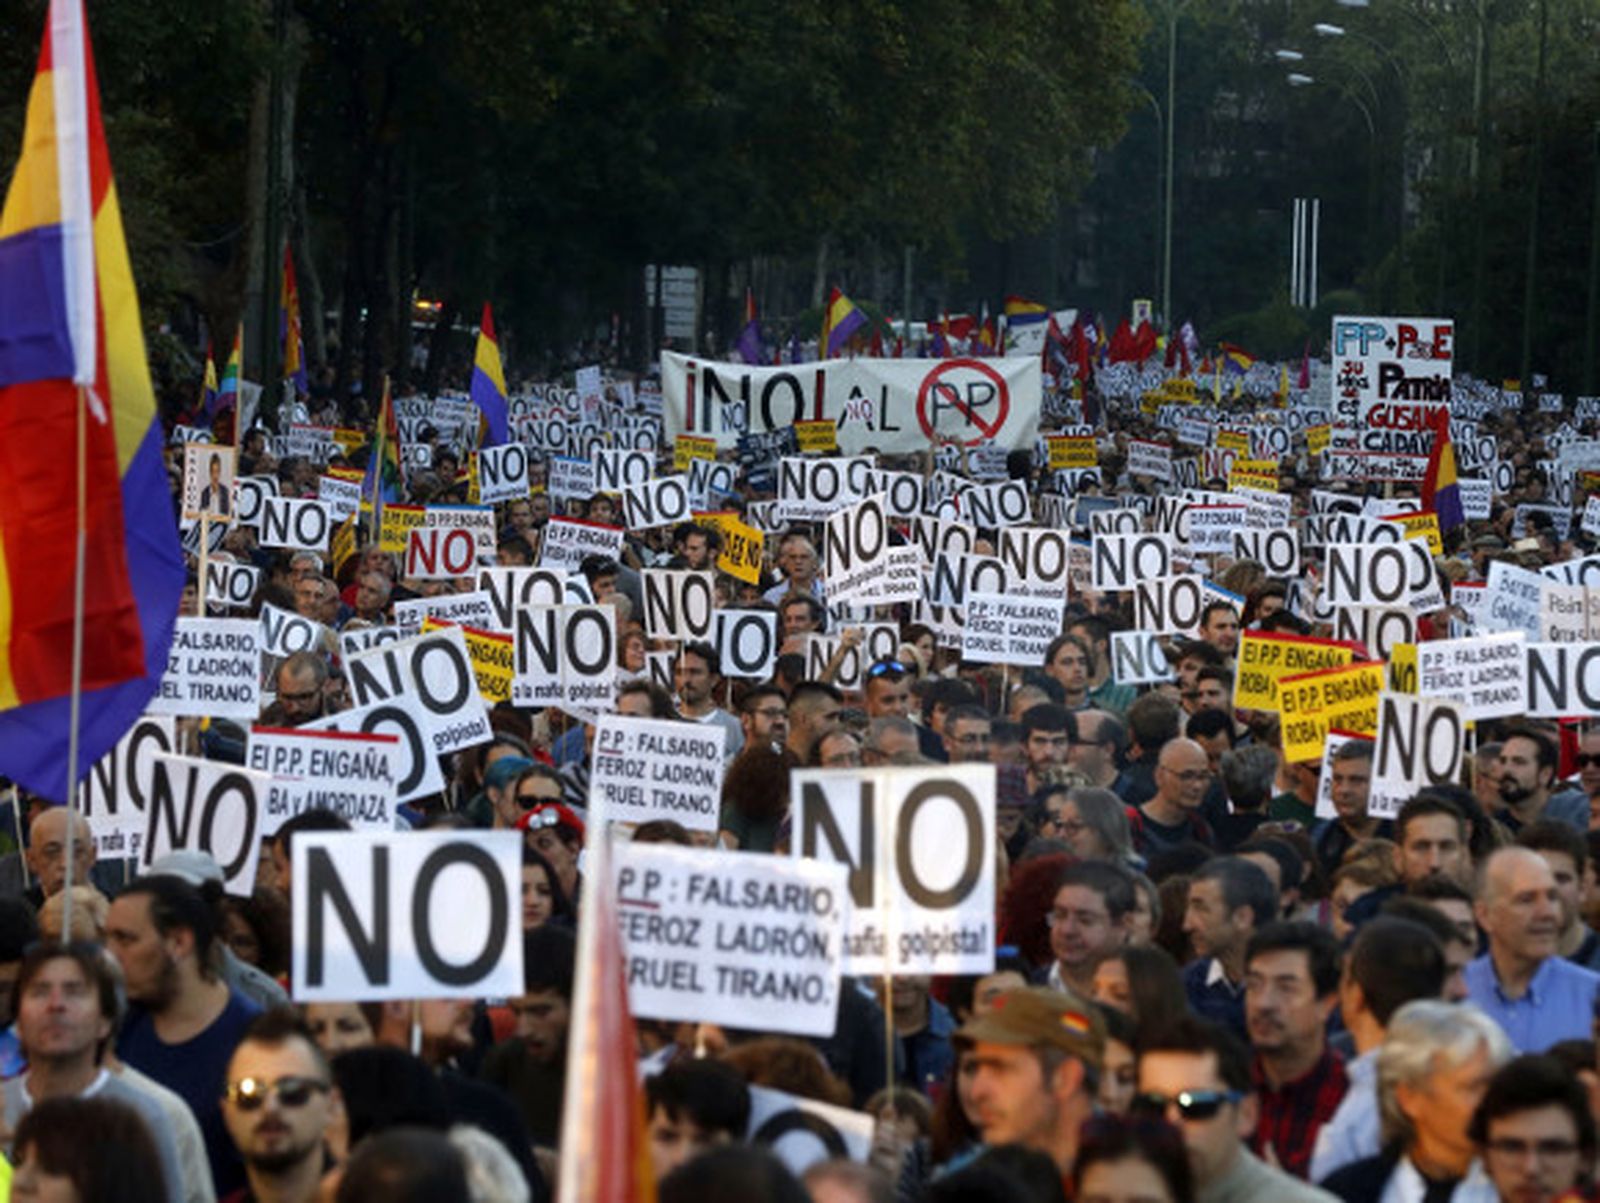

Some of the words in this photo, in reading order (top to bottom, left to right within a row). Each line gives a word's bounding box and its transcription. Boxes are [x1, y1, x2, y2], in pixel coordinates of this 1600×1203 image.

[1336, 322, 1387, 356] PP
[722, 402, 746, 433] NO
[847, 399, 873, 421] NO
[931, 382, 996, 428] PP
[1366, 403, 1442, 432] GUSAN
[528, 421, 566, 448] NO
[615, 431, 655, 451] NO
[1364, 432, 1437, 454] CADAV
[1461, 438, 1496, 466] NO
[481, 447, 525, 487] NO
[597, 451, 651, 489] NO
[690, 460, 732, 494] NO
[782, 460, 839, 502] NO
[1060, 469, 1101, 498] NO
[624, 480, 687, 528] NO
[865, 471, 919, 515] NO
[971, 484, 1027, 529] NO
[263, 500, 327, 547] NO
[750, 502, 784, 532] NO
[1093, 512, 1139, 535] NO
[1336, 515, 1401, 544] NO
[409, 528, 474, 575] NO
[828, 499, 885, 579] NO
[914, 516, 971, 564] NO
[1002, 531, 1065, 583] NO
[1235, 530, 1296, 574] NO
[207, 562, 254, 602] NO
[933, 552, 1007, 604] NO
[1096, 537, 1169, 586] NO
[1329, 546, 1407, 603] NO
[481, 571, 563, 630] NO
[646, 573, 712, 641] NO
[1000, 604, 1060, 625] FALSARIO,
[1138, 578, 1201, 632] NO
[345, 628, 399, 656] NO
[519, 608, 612, 676] NO
[717, 614, 771, 674] O
[966, 637, 1006, 656] CRUEL
[1339, 607, 1413, 662] NO
[187, 657, 257, 679] LADRÓN,
[350, 637, 471, 717] NO
[808, 640, 860, 688] NO
[1114, 634, 1170, 682] NO
[1391, 661, 1417, 695] NO
[1526, 645, 1600, 712] NO
[188, 683, 256, 703] TIRANO.
[1240, 672, 1270, 694] ROBA
[1282, 690, 1296, 714] El
[1323, 669, 1380, 706] ENGAÑA
[1422, 672, 1464, 690] FEROZ
[432, 715, 489, 752] golpista!
[638, 733, 724, 764] FALSARIO,
[1286, 721, 1320, 746] ROBA
[1378, 697, 1462, 786] NO
[84, 721, 172, 819] NO
[252, 744, 269, 771] El
[273, 747, 305, 774] P.P.
[309, 746, 393, 787] ENGAÑA,
[597, 756, 648, 780] FEROZ
[653, 761, 718, 792] LADRÓN,
[144, 760, 258, 882] NO
[652, 790, 716, 817] TIRANO.
[802, 777, 985, 910] NO
[305, 842, 508, 987] NO
[686, 876, 840, 921] FALSARIO,
[713, 926, 834, 967] LADRÓN,
[900, 923, 987, 964] golpista!
[623, 957, 707, 994] RUEL
[714, 969, 832, 1006] TIRANO.
